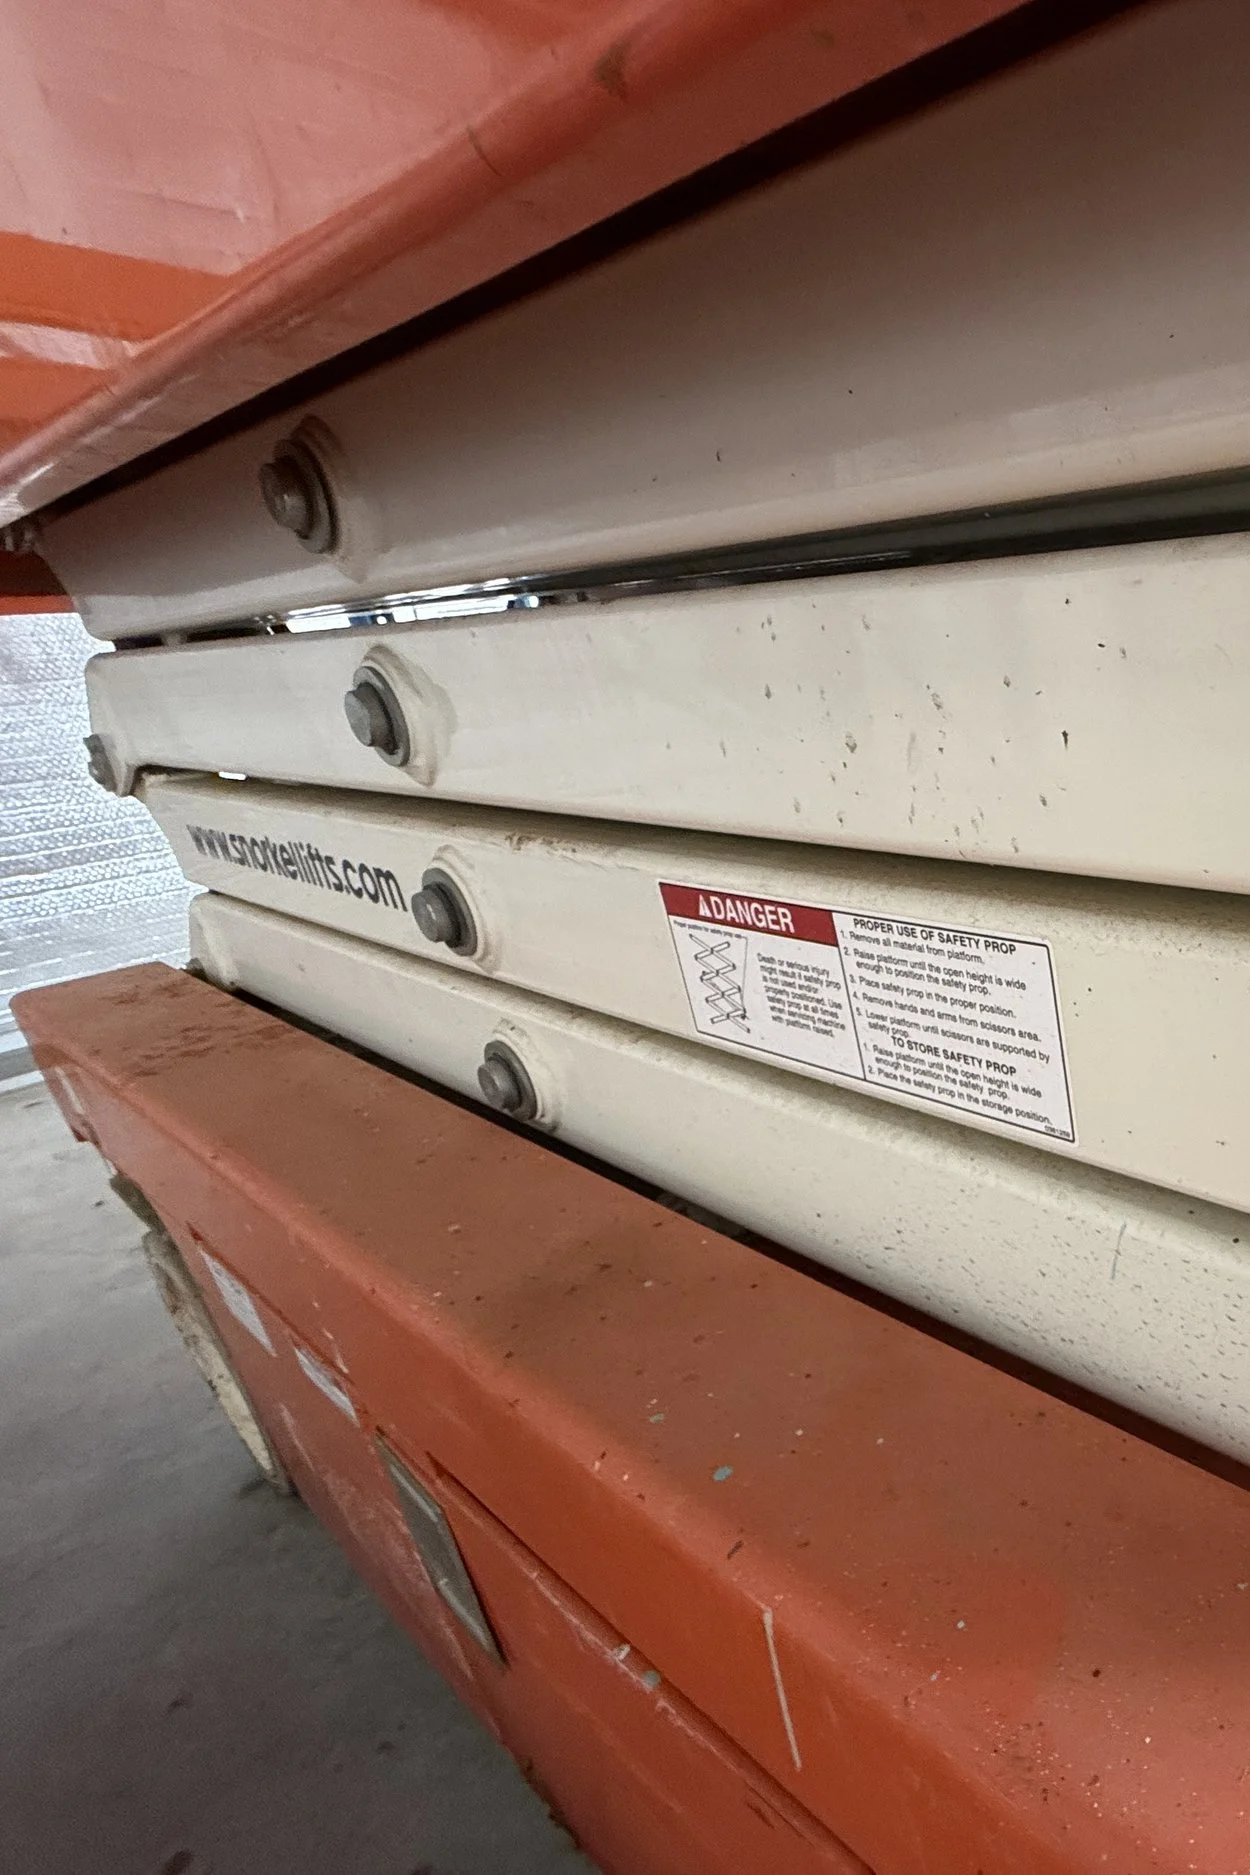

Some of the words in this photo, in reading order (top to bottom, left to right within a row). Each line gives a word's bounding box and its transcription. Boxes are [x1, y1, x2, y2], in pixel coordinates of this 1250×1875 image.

[186, 824, 408, 912] www.snorkellifts.com
[710, 896, 795, 933] DANGER
[840, 930, 847, 939] 1.
[849, 931, 881, 945] Remove
[882, 938, 891, 947] all
[893, 941, 925, 953] material
[926, 944, 945, 956] from
[947, 950, 984, 964] platform.
[853, 918, 894, 934] PROPER
[896, 925, 918, 938] USE
[920, 929, 934, 941] OF
[938, 932, 980, 949] SAFETY
[984, 940, 1016, 955] PROP
[853, 948, 875, 961] Raise
[876, 954, 908, 967] platform
[910, 962, 926, 970] until
[928, 963, 941, 974] the
[943, 968, 964, 978] open
[966, 970, 993, 985] height
[995, 976, 1003, 986] is
[1005, 979, 1026, 991] wide
[856, 961, 883, 974] enough
[885, 966, 893, 975] to
[894, 969, 925, 981] position
[926, 974, 940, 985] the
[942, 978, 967, 992] safety
[969, 984, 991, 996] prop.
[859, 976, 880, 989] Place
[881, 983, 904, 996] safety
[906, 988, 924, 999] prop
[935, 993, 948, 1004] the
[950, 997, 977, 1009] proper
[979, 1004, 1016, 1018] position.
[862, 992, 893, 1008] Remove
[894, 1000, 918, 1014] hands
[920, 1008, 935, 1018] and
[937, 1012, 957, 1023] arms
[959, 1015, 978, 1027] from
[980, 1021, 1016, 1036] scissors
[1018, 1030, 1041, 1042] area.
[866, 1010, 888, 1022] Lower
[890, 1017, 921, 1030] platform
[922, 1026, 939, 1034] until
[941, 1029, 974, 1044] scissors
[976, 1038, 990, 1048] are
[992, 1042, 1037, 1059] supported
[1038, 1051, 1050, 1064] by
[868, 1022, 890, 1035] safety
[873, 1044, 894, 1058] Raise
[895, 1053, 926, 1065] platform
[928, 1062, 944, 1071] until
[946, 1065, 959, 1075] the
[961, 1070, 981, 1081] open
[983, 1075, 1009, 1089] height
[1012, 1083, 1019, 1092] is
[1021, 1087, 1042, 1098] wide
[875, 1057, 902, 1071] enough
[903, 1063, 911, 1072] to
[913, 1067, 943, 1080] position
[944, 1075, 957, 1085] the
[959, 1080, 984, 1095] safety
[891, 1036, 905, 1048] TO
[907, 1040, 941, 1057] STORE
[942, 1049, 982, 1068] SAFETY
[986, 1060, 1016, 1076] PROP
[878, 1068, 898, 1081] Place
[899, 1075, 911, 1085] the
[913, 1079, 936, 1093] safety
[937, 1086, 956, 1099] prop
[958, 1091, 965, 1100] in
[966, 1093, 980, 1104] the
[982, 1099, 1013, 1115] storage
[1015, 1108, 1052, 1125] position.
